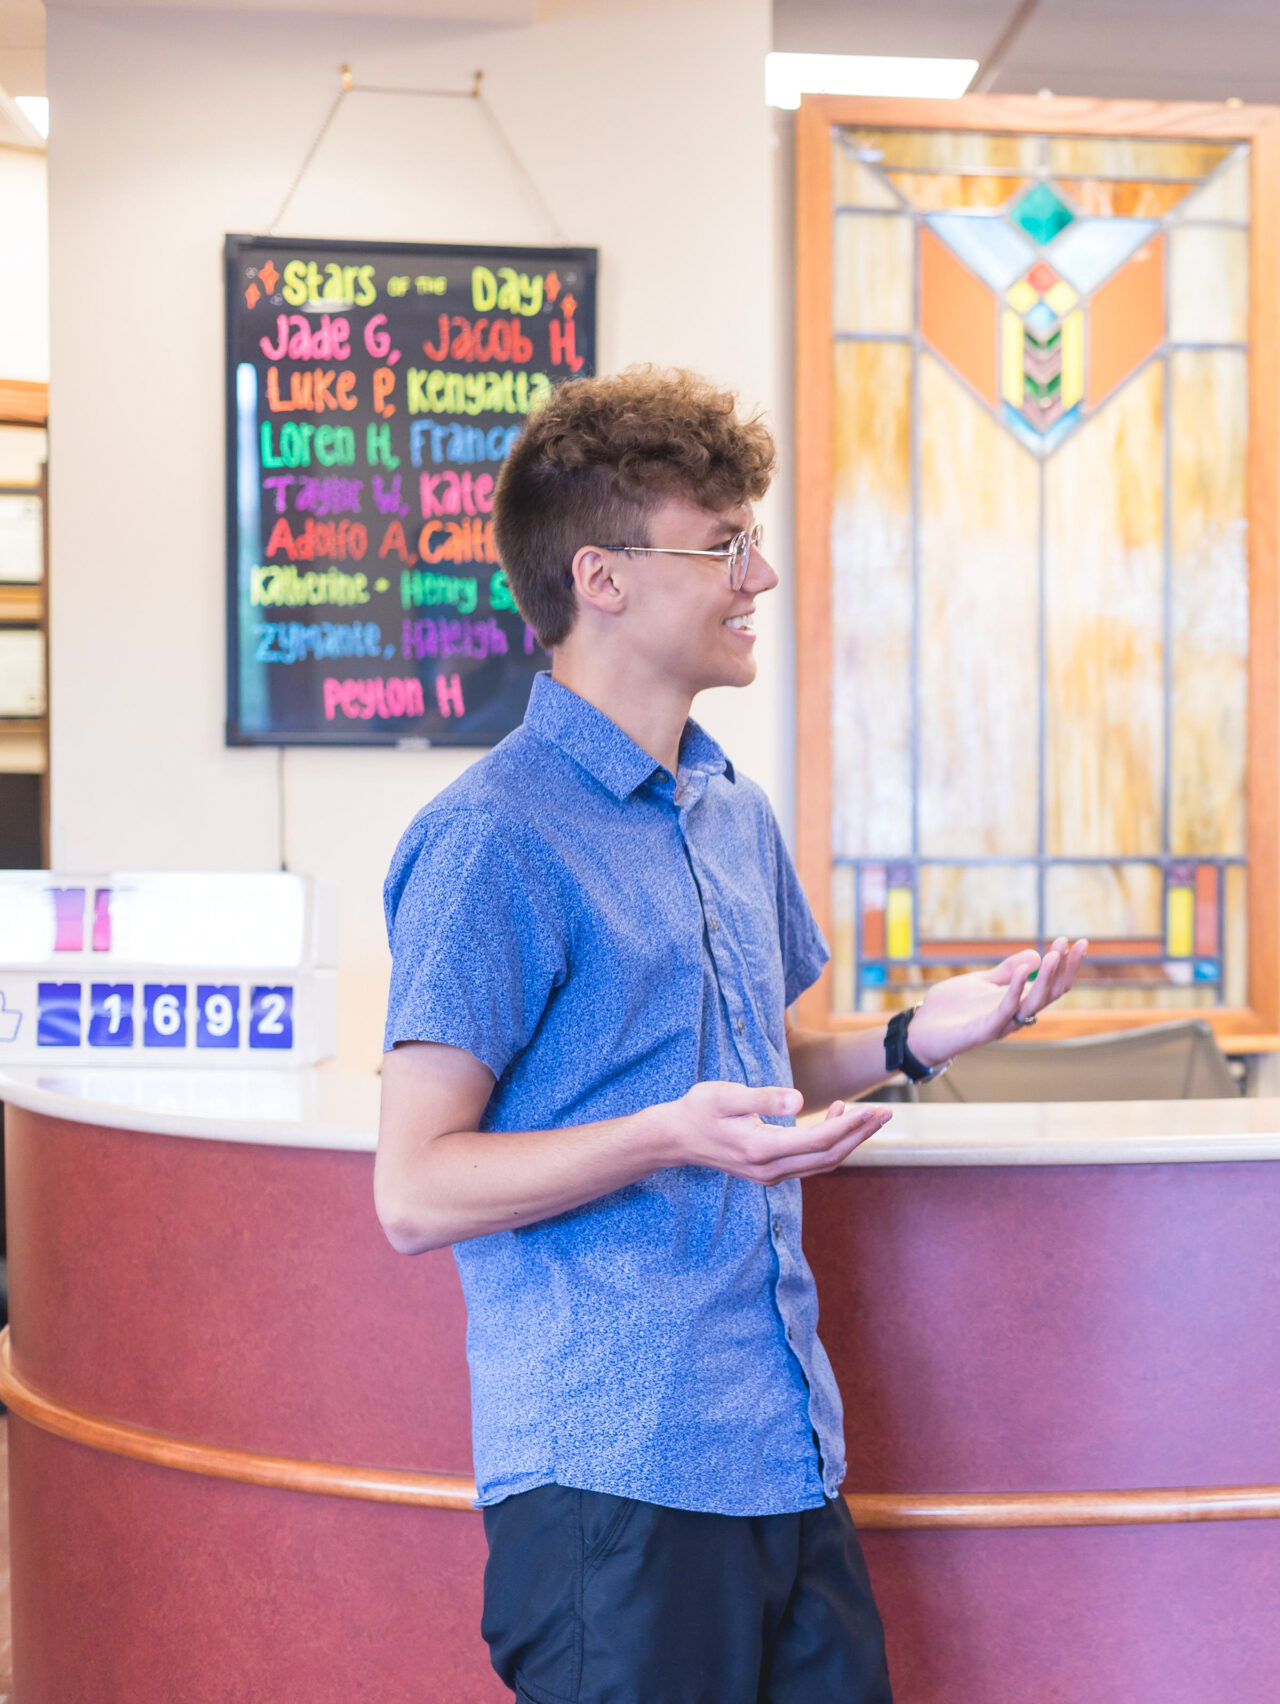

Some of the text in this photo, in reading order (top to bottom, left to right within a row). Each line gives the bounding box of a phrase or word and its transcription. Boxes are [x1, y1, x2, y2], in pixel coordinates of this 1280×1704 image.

[282, 260, 377, 307] Stars
[472, 266, 544, 317] Day
[260, 314, 351, 361] Jade
[422, 313, 533, 363] Jacob
[267, 366, 358, 413] Luke
[261, 421, 356, 468] Loren
[265, 517, 368, 562] Adolfo
[418, 517, 499, 565] Caitl
[400, 569, 478, 614] Henry
[323, 673, 465, 720] Peyton H
[103, 993, 287, 1037] 1692
